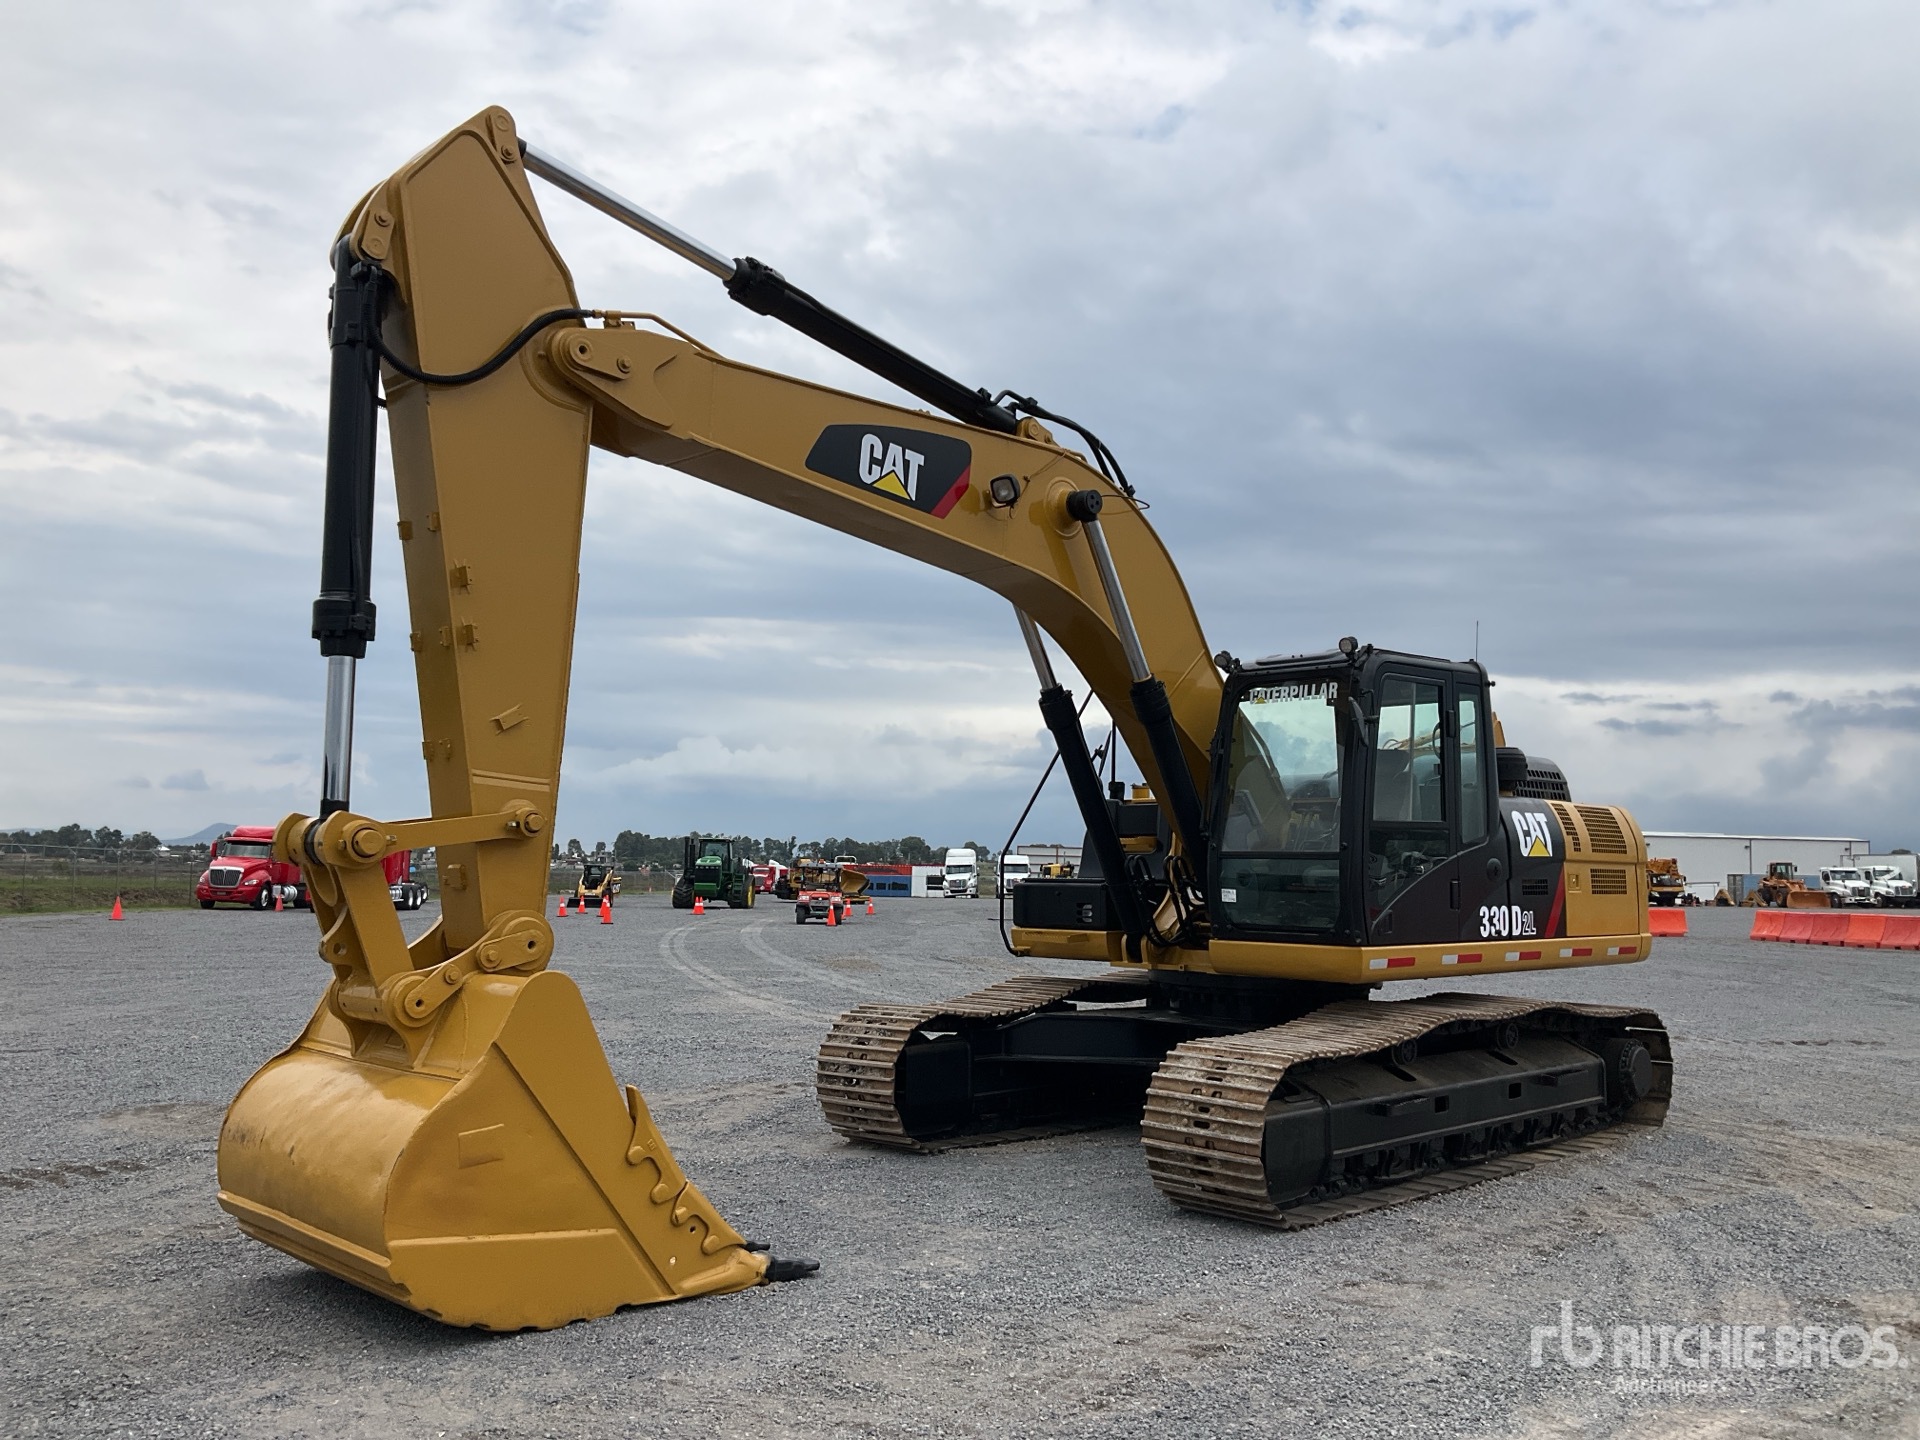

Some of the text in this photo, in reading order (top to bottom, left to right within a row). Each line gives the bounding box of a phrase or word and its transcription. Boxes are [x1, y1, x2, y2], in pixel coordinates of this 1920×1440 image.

[859, 433, 925, 501] CAT
[1250, 681, 1338, 705] CATERPILLAR
[1511, 810, 1553, 857] CAT
